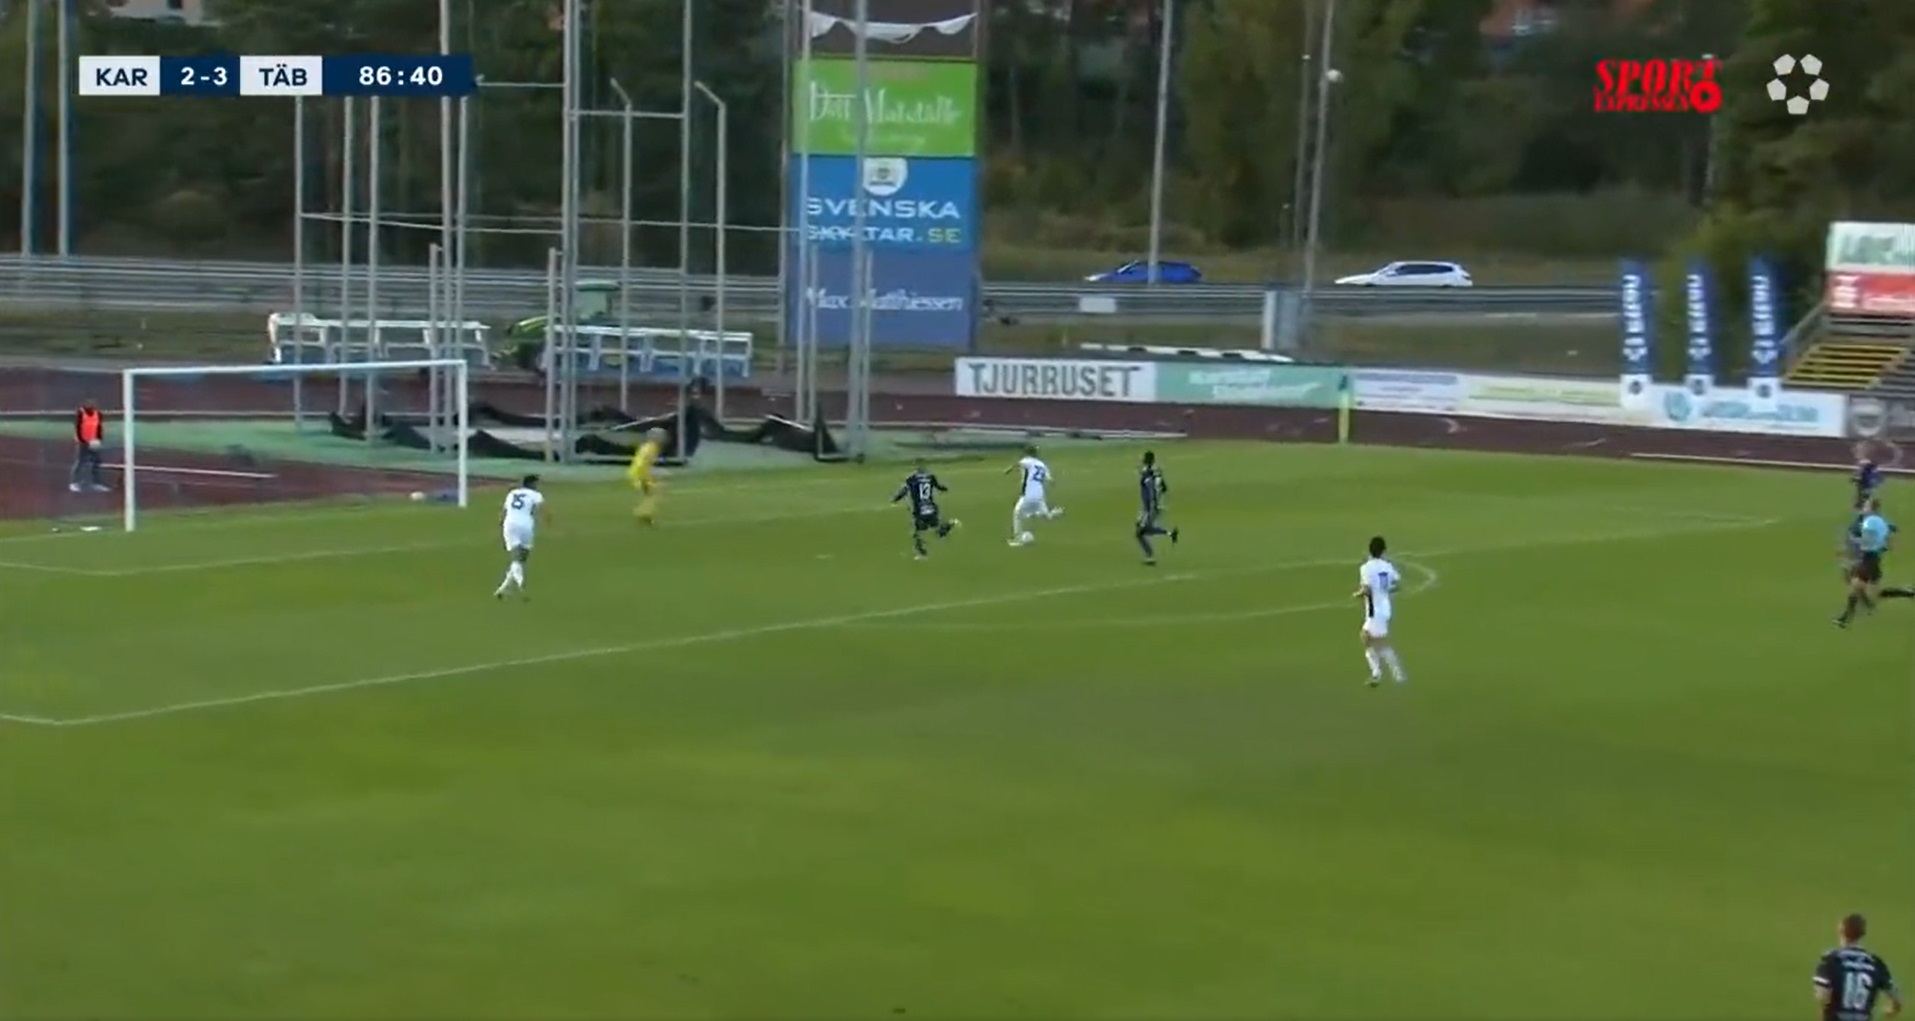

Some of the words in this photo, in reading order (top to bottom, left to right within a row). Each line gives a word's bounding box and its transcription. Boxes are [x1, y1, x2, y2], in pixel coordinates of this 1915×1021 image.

[806, 197, 961, 219] SVENSKA
[968, 361, 1142, 398] TJURRUSET
[510, 493, 528, 510] 15
[918, 482, 932, 501] 13
[1842, 971, 1874, 1010] 16
